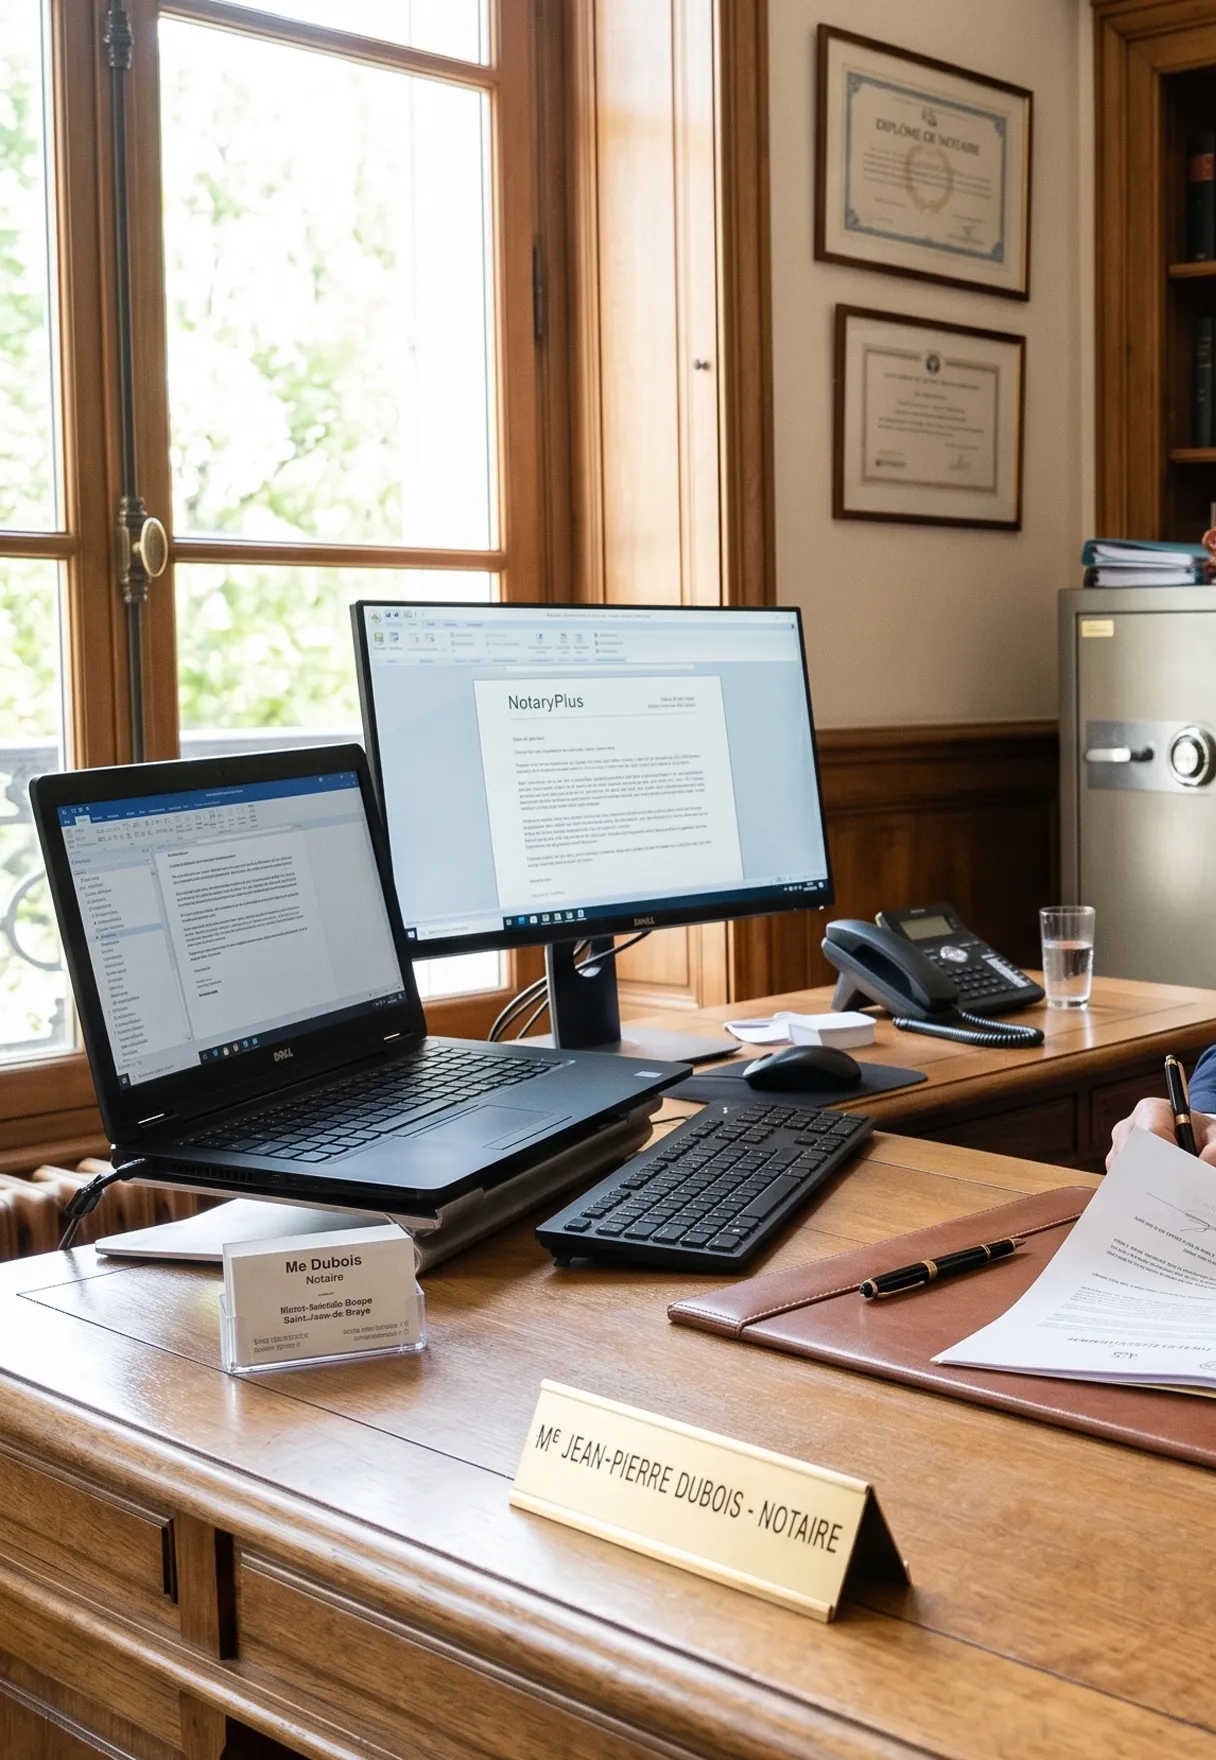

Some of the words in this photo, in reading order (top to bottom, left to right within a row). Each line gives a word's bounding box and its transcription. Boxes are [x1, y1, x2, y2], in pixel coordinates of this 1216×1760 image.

[508, 693, 584, 713] NotaryPlus
[285, 1260, 307, 1274] Me
[311, 1254, 363, 1271] Dubois
[305, 1273, 344, 1285] Notaire
[561, 1434, 674, 1494] JEAN-PIERRE
[674, 1472, 744, 1518] DUBOIS
[758, 1500, 843, 1554] NOTAIRE
